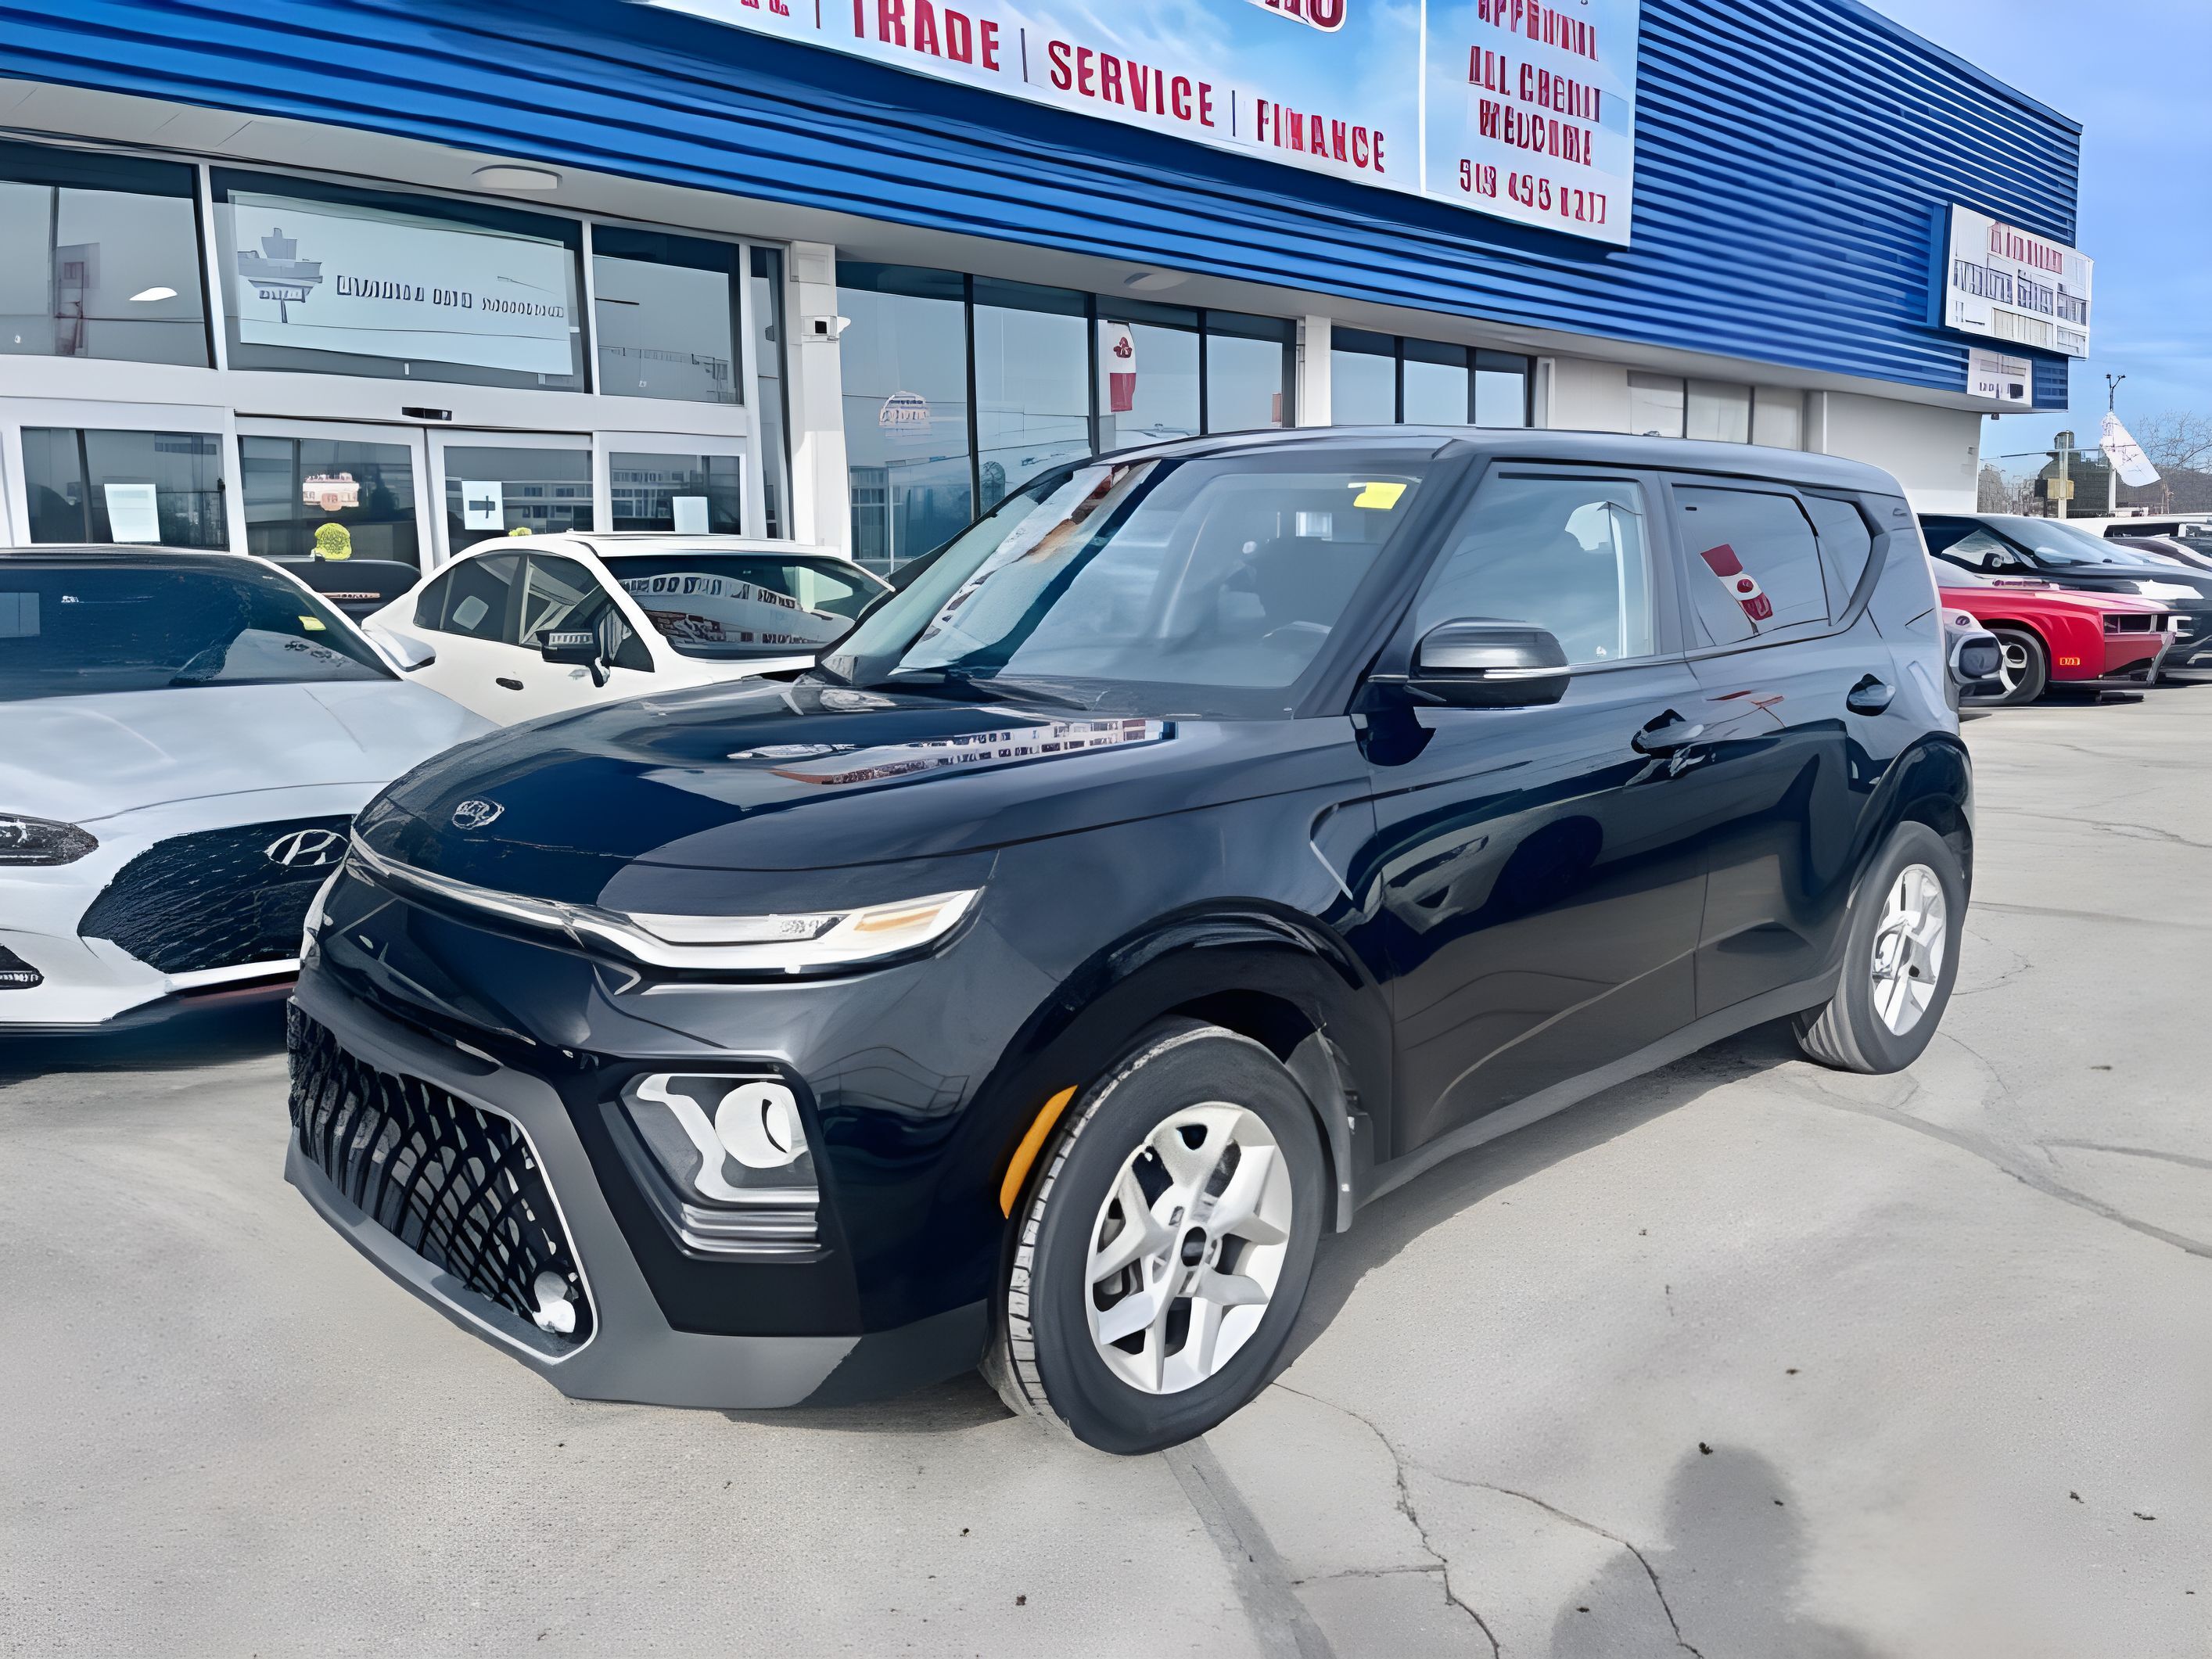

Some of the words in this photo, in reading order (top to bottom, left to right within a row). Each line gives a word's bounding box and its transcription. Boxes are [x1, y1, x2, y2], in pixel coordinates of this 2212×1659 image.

[852, 0, 1000, 71] TRADE
[1048, 40, 1215, 127] SERVICE
[1257, 99, 1384, 173] FINANCE
